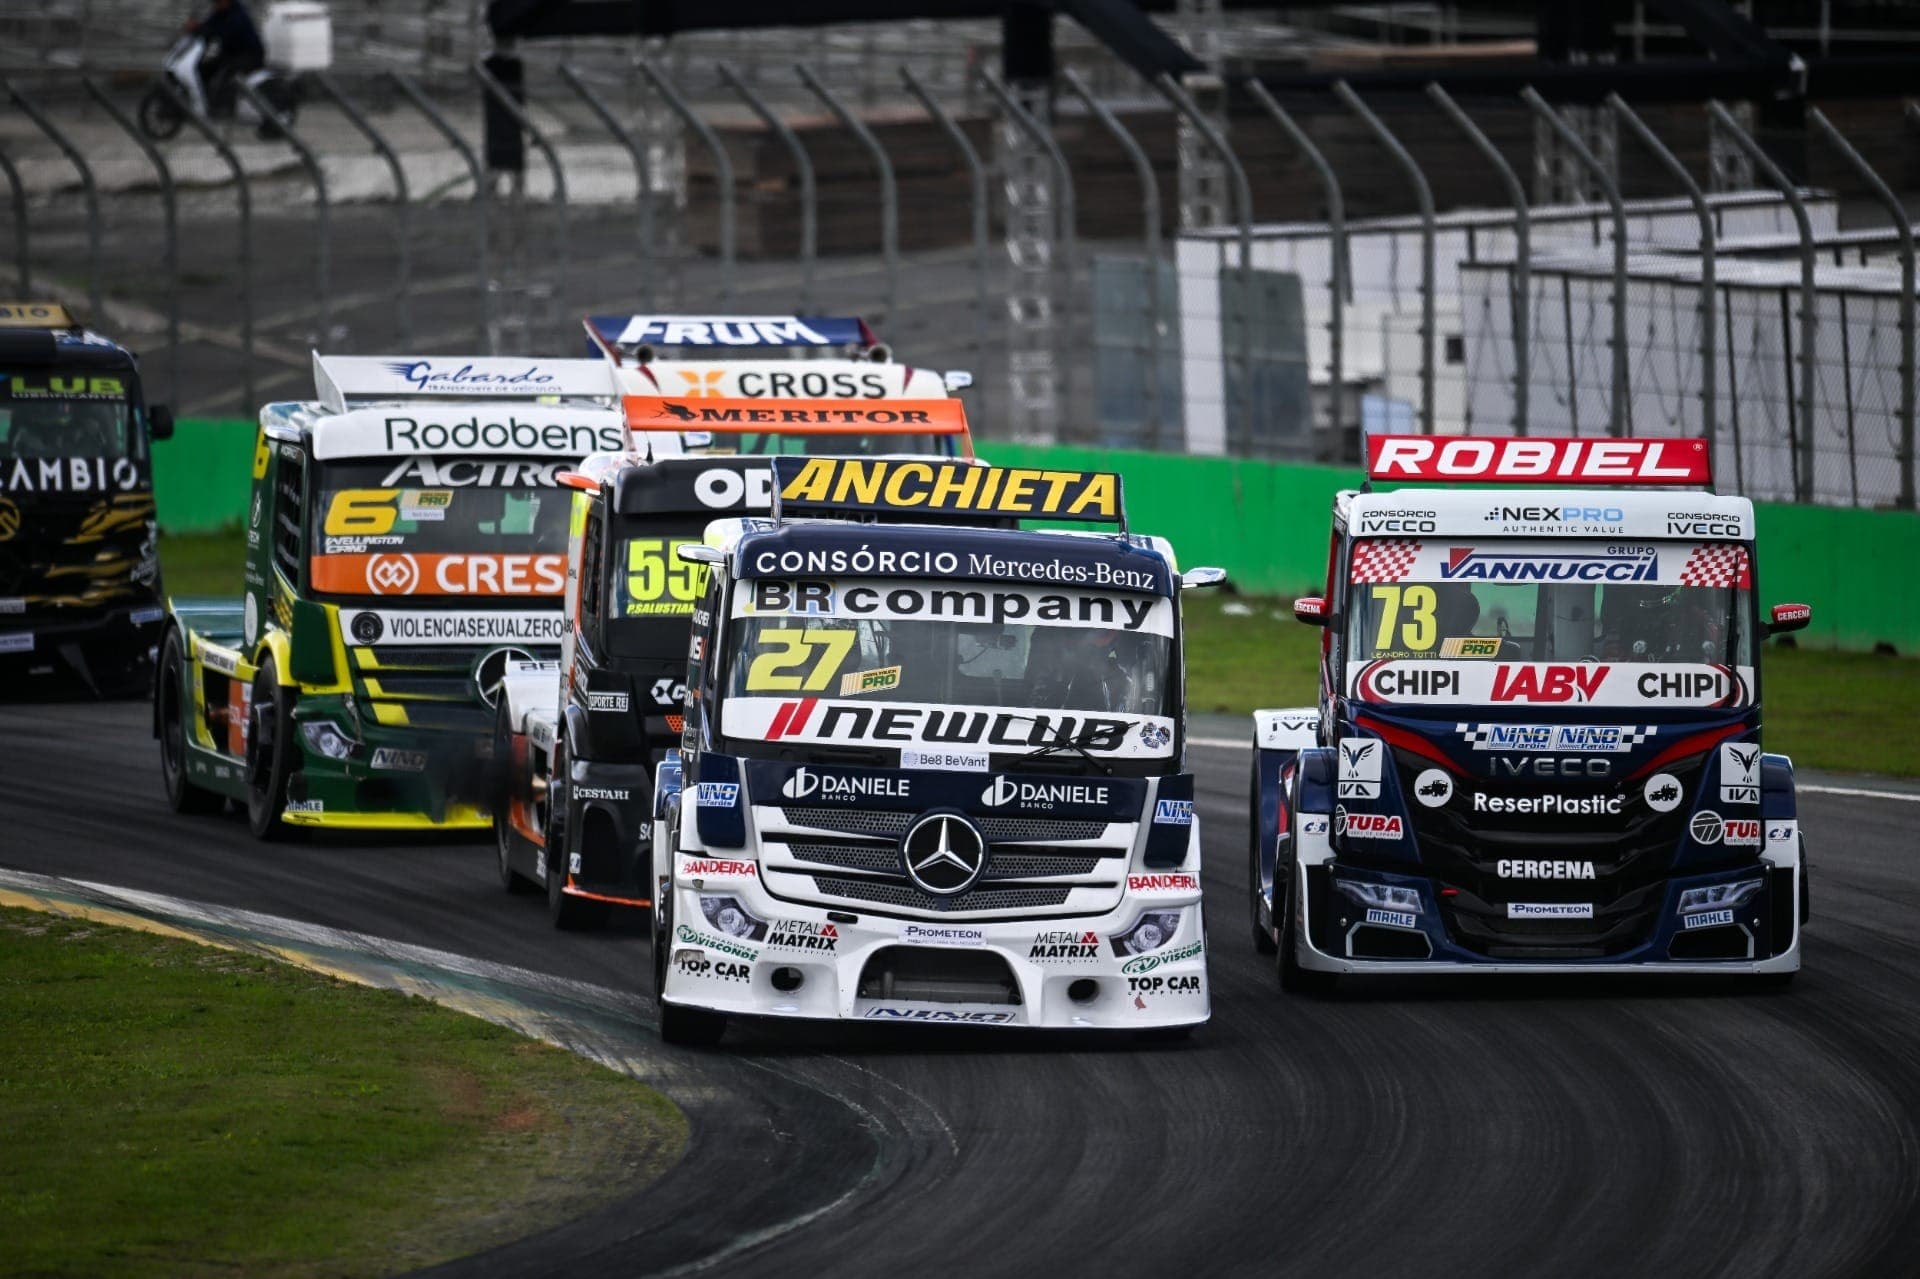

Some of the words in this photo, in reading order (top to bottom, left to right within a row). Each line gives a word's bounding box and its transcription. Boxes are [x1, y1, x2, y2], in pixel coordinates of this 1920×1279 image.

[618, 315, 829, 345] FRUM
[404, 361, 554, 391] Gabardo
[11, 377, 125, 394] LUB
[738, 371, 887, 399] CROSS
[701, 408, 933, 424] MERITOR
[385, 417, 624, 452] Rodobens
[1374, 440, 1692, 478] ROBIEL
[0, 457, 138, 491] AMBIO
[781, 459, 1119, 517] ANCHIETA
[324, 489, 400, 536] 6
[1503, 507, 1624, 522] NEXPRO
[1361, 520, 1436, 533] IVECO
[1503, 525, 1577, 533] AUTHENTIC
[1584, 526, 1625, 534] VALUE
[1667, 522, 1741, 536] IVECO
[325, 536, 405, 545] WELLINGTON
[1607, 546, 1656, 556] GRUPO
[435, 556, 565, 594] CRES
[628, 540, 699, 601] 55
[756, 544, 959, 574] CONSÓRCIO
[968, 553, 1155, 590] Mercedes-Benz
[755, 580, 835, 614] BR
[844, 587, 1154, 631] company
[1372, 585, 1437, 651] 73
[1371, 650, 1410, 659] LEANDRO
[1461, 645, 1496, 655] PRO
[746, 629, 857, 691] 27
[862, 674, 896, 689] PRO
[1374, 669, 1460, 695] CHIPI
[1637, 672, 1723, 699] CHIPI
[920, 754, 942, 765] Be8
[945, 754, 986, 768] BeVant
[1489, 756, 1612, 777] IVECO
[578, 788, 630, 800] CESTARI
[822, 775, 910, 797] DANIELE
[1021, 783, 1109, 805] DANIELE
[1340, 783, 1371, 796] IVA
[1728, 788, 1759, 801] IVA
[821, 793, 856, 802] BANCO
[1020, 801, 1054, 810] BANCO
[1474, 792, 1622, 814] ReserPlastic
[1347, 815, 1401, 832] TUBA
[1725, 822, 1760, 838] TUB
[683, 860, 757, 877] BANDEIRA
[1497, 859, 1596, 880] CERCENA
[1128, 874, 1199, 891] BANDEIRA
[1511, 904, 1590, 914] PROMETEON
[1368, 910, 1414, 926] MAHLE
[1686, 911, 1732, 927] MAHLE
[774, 919, 821, 936] METAL
[904, 925, 982, 939] PROMETEON
[767, 932, 839, 952] MATRIX
[1034, 931, 1081, 944] METAL
[698, 936, 758, 962] VISCONDE
[1028, 945, 1099, 957] MATRIX
[714, 961, 751, 979] CAR
[1128, 977, 1163, 991] TOP
[1167, 975, 1201, 990] CAR
